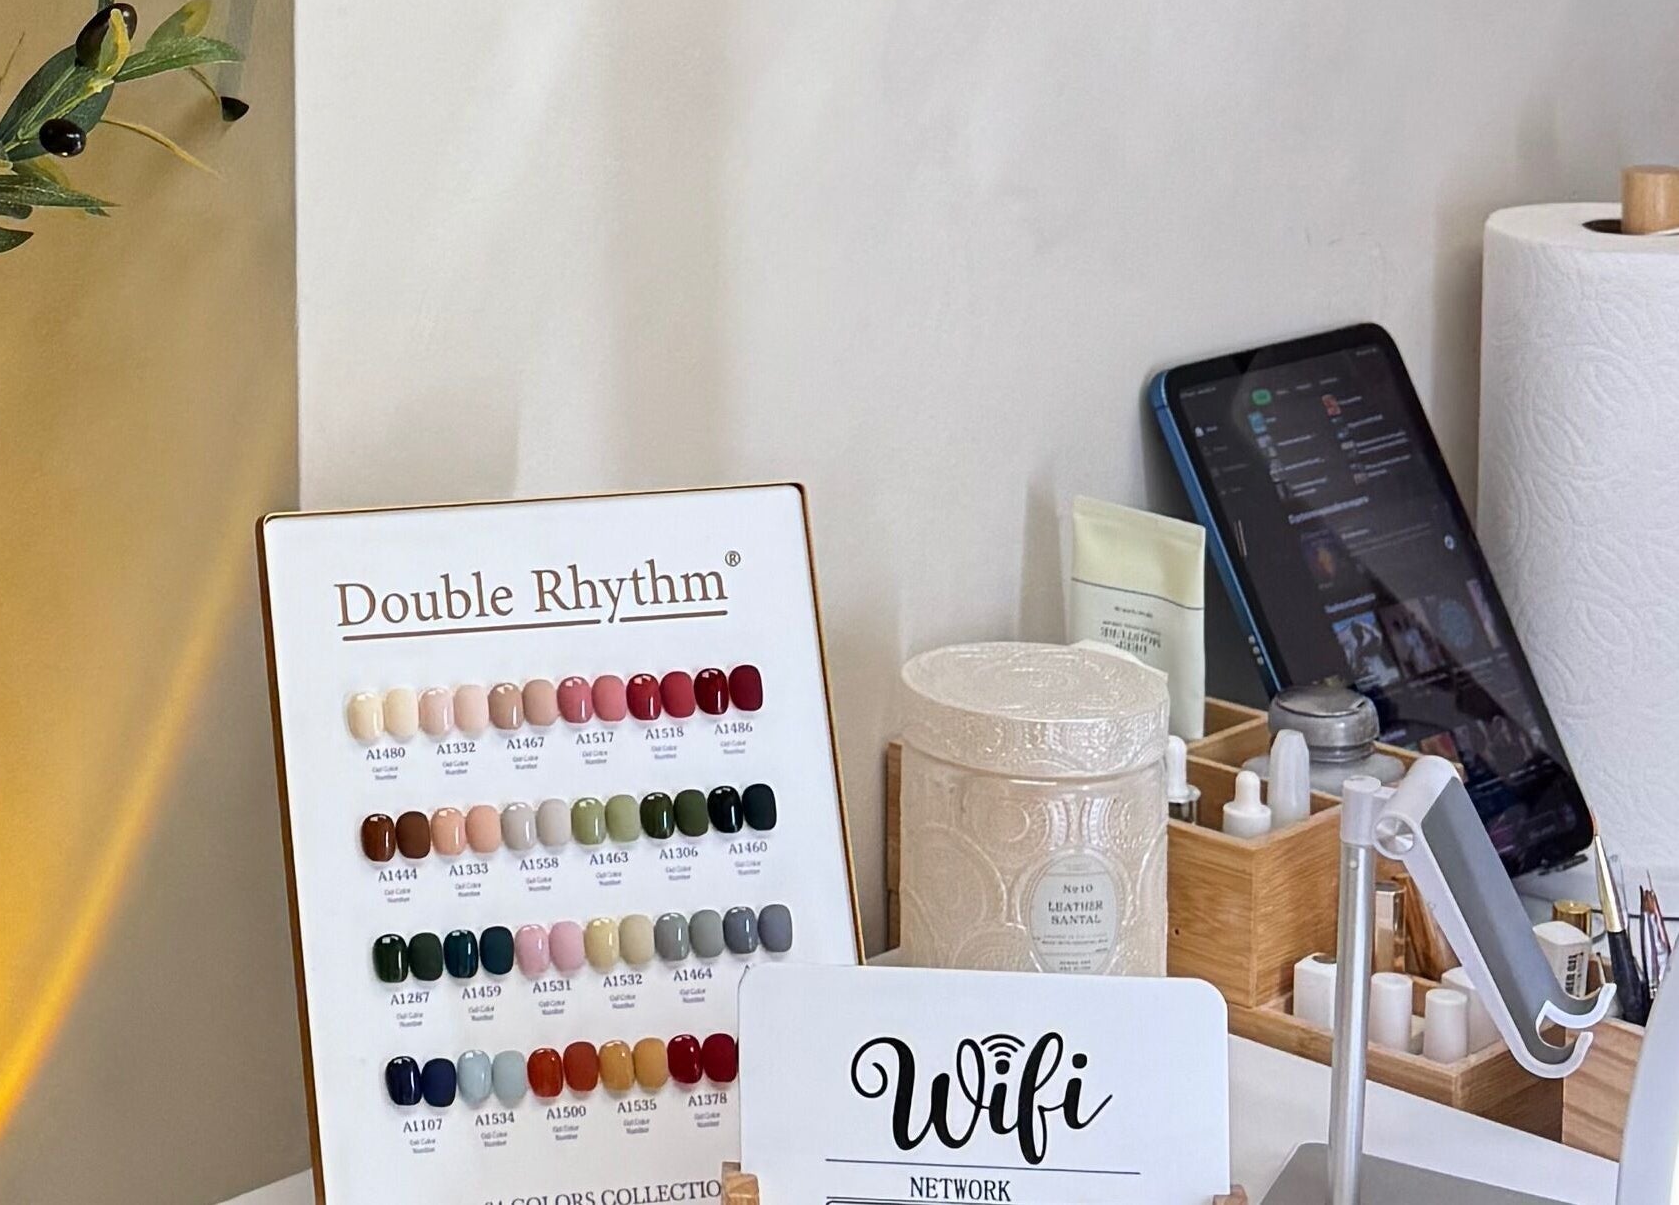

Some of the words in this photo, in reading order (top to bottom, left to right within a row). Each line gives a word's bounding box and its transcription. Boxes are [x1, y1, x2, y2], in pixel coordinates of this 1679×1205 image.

[333, 571, 514, 627] Double
[645, 726, 684, 740] A1518
[714, 721, 753, 735] A1486
[506, 737, 545, 750] A1467
[576, 731, 614, 745] A1517
[366, 747, 406, 760] A1480
[436, 742, 476, 755] A1332
[659, 846, 699, 860] A1306
[728, 841, 768, 855] A1460
[519, 857, 559, 871] A1558
[589, 851, 629, 865] A1463
[378, 868, 418, 882] A1444
[449, 862, 489, 876] A1333
[603, 973, 643, 988] A1532
[673, 967, 713, 981] A1464
[461, 985, 502, 999] A1459
[532, 979, 572, 993] A1531
[688, 1092, 728, 1107] A1378
[850, 1031, 1113, 1165] Wifi
[546, 1105, 587, 1120] A1500
[617, 1098, 657, 1113] A1535
[403, 1118, 443, 1133] A1107
[474, 1111, 515, 1126] A1534
[909, 1176, 1012, 1202] NETWORK
